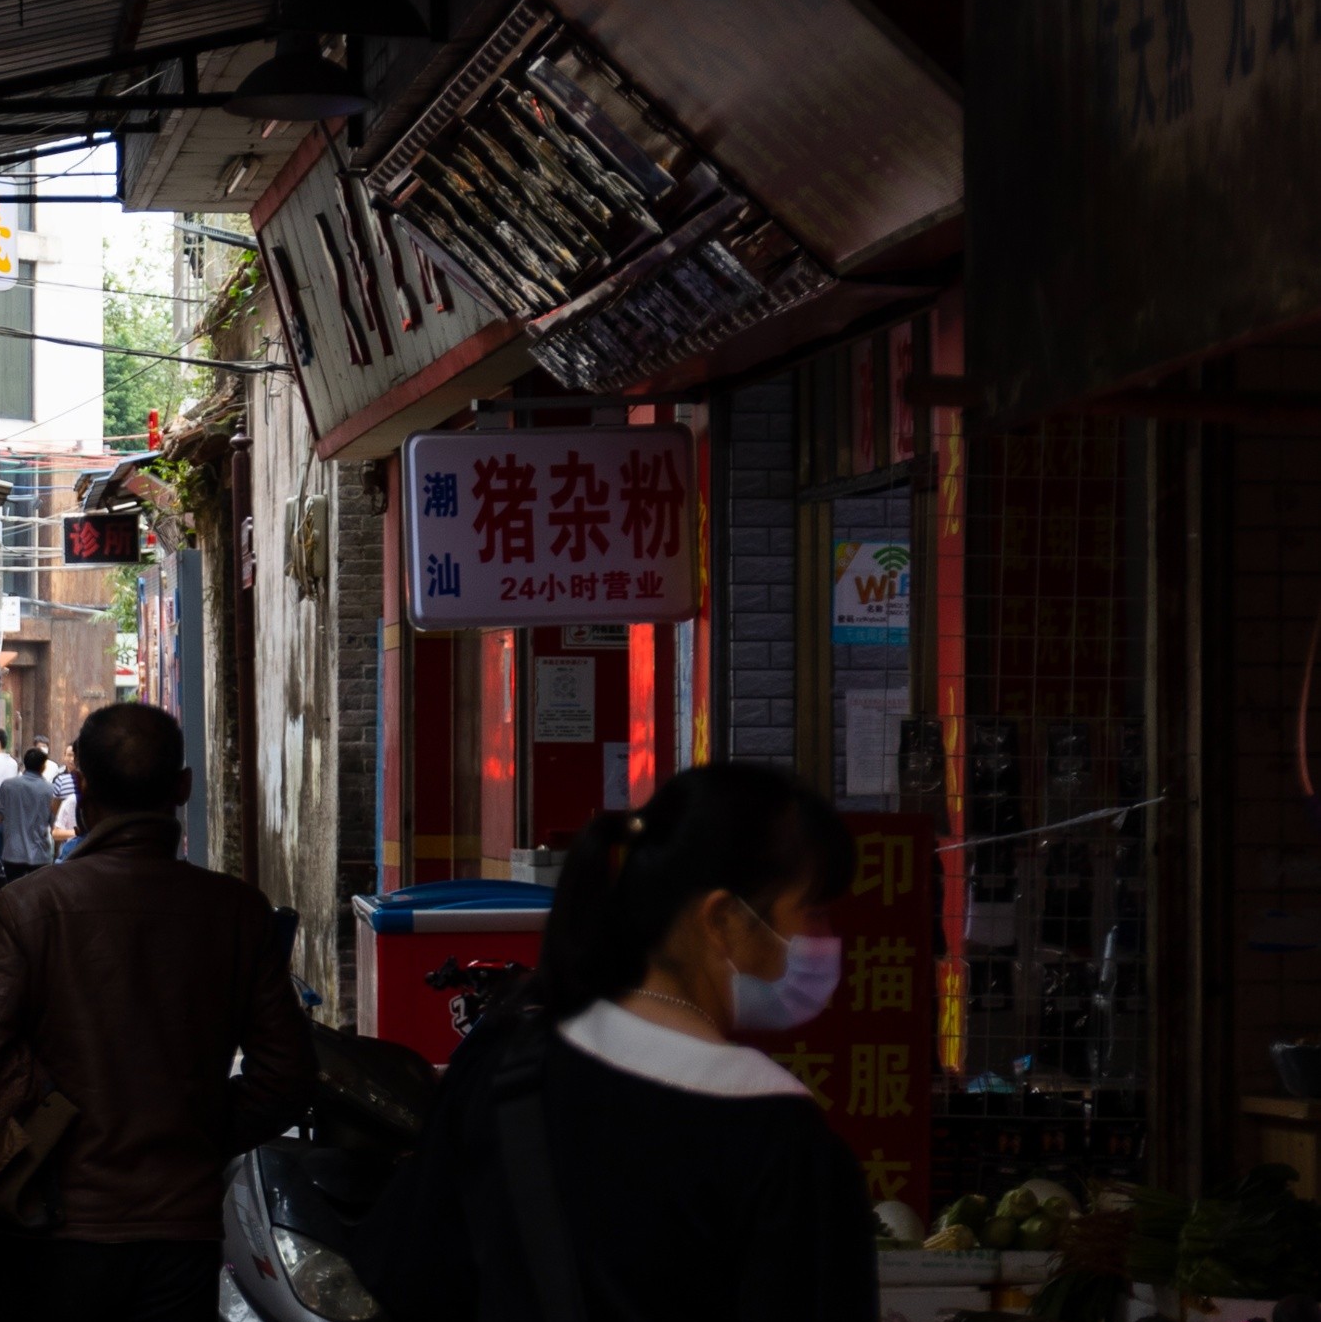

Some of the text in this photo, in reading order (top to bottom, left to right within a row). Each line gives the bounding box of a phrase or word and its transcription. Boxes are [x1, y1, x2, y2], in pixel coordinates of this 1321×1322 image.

[424, 472, 461, 598] 潮汕
[472, 450, 685, 563] 猪杂粉
[500, 571, 665, 602] 24小时营业
